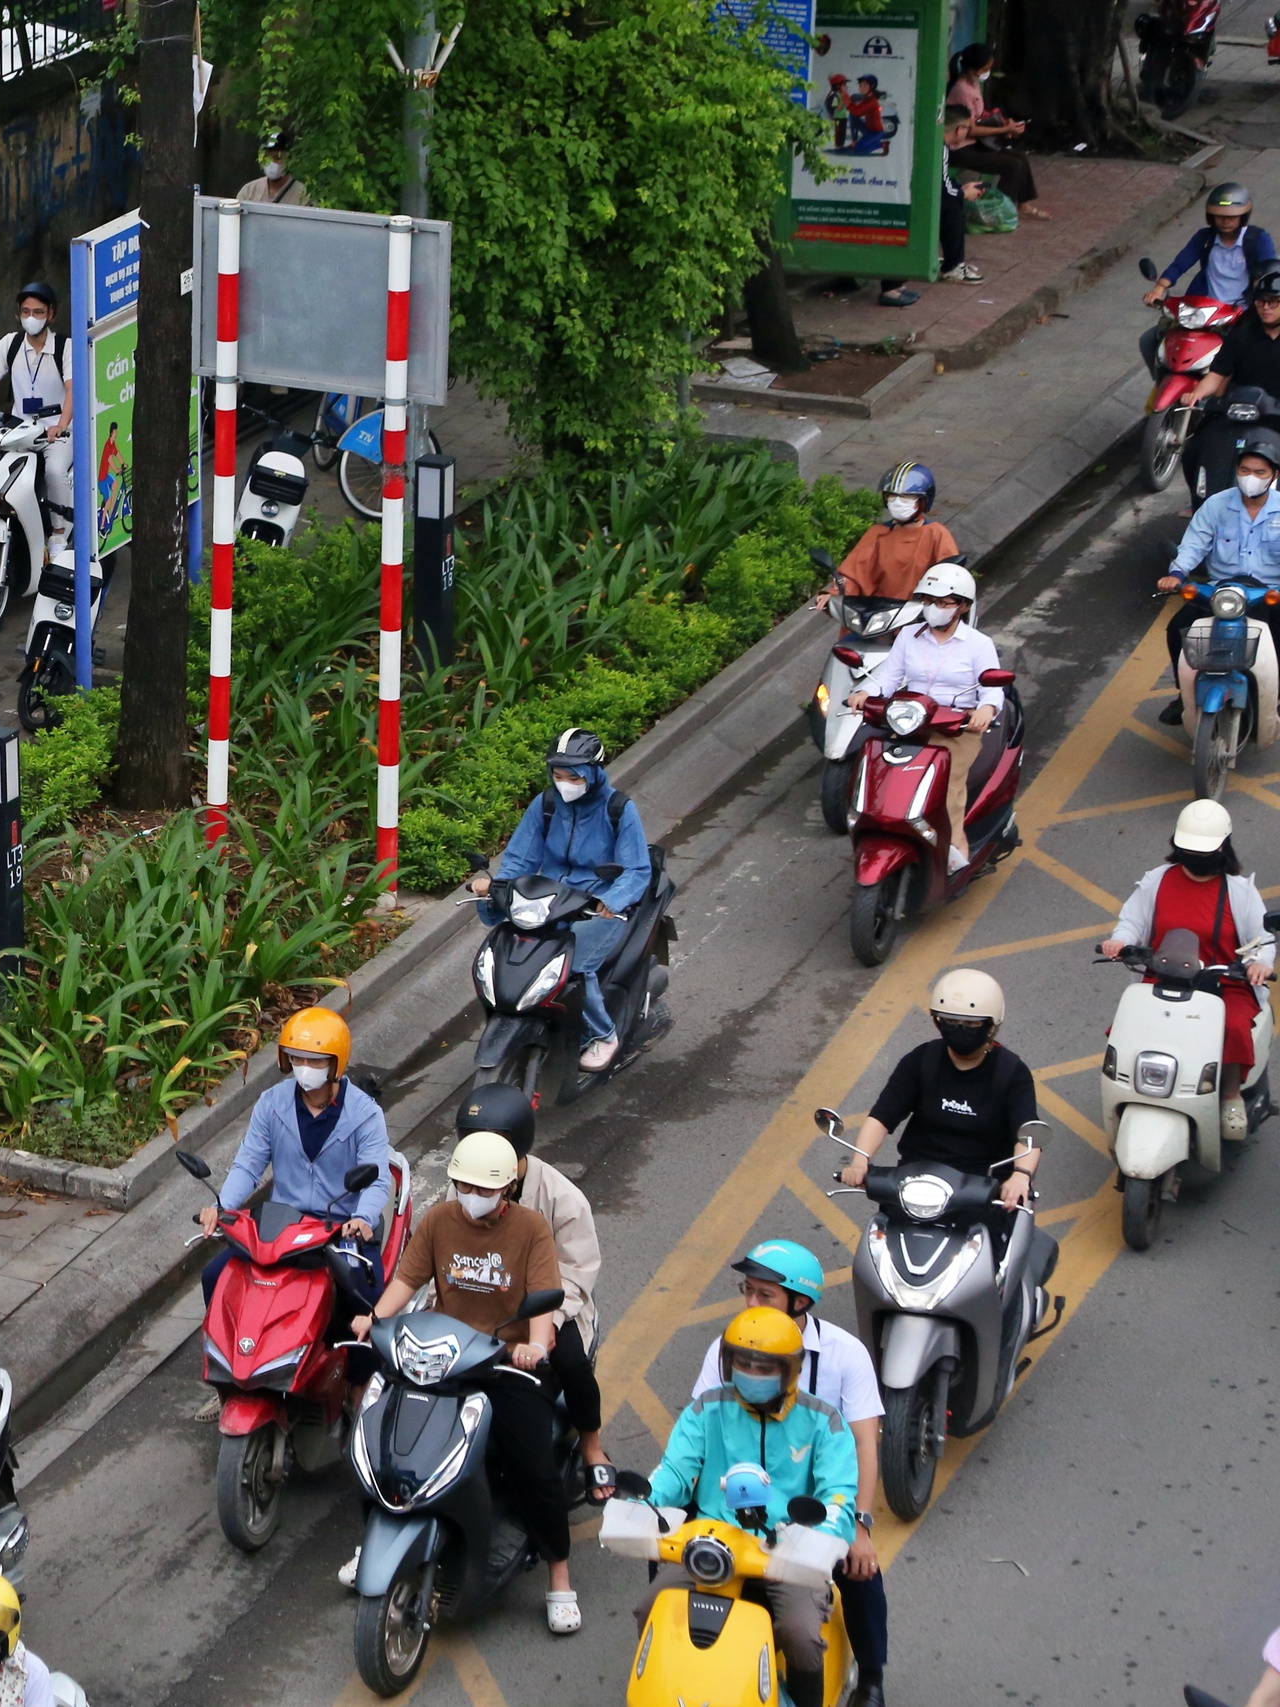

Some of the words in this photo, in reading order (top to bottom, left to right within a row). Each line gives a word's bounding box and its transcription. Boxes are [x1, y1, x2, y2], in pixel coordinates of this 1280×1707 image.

[443, 571, 453, 592] 18
[10, 865, 22, 889] 19
[406, 1393, 429, 1403] HONDA
[593, 1465, 609, 1485] G
[692, 1601, 724, 1613] VINFAST
